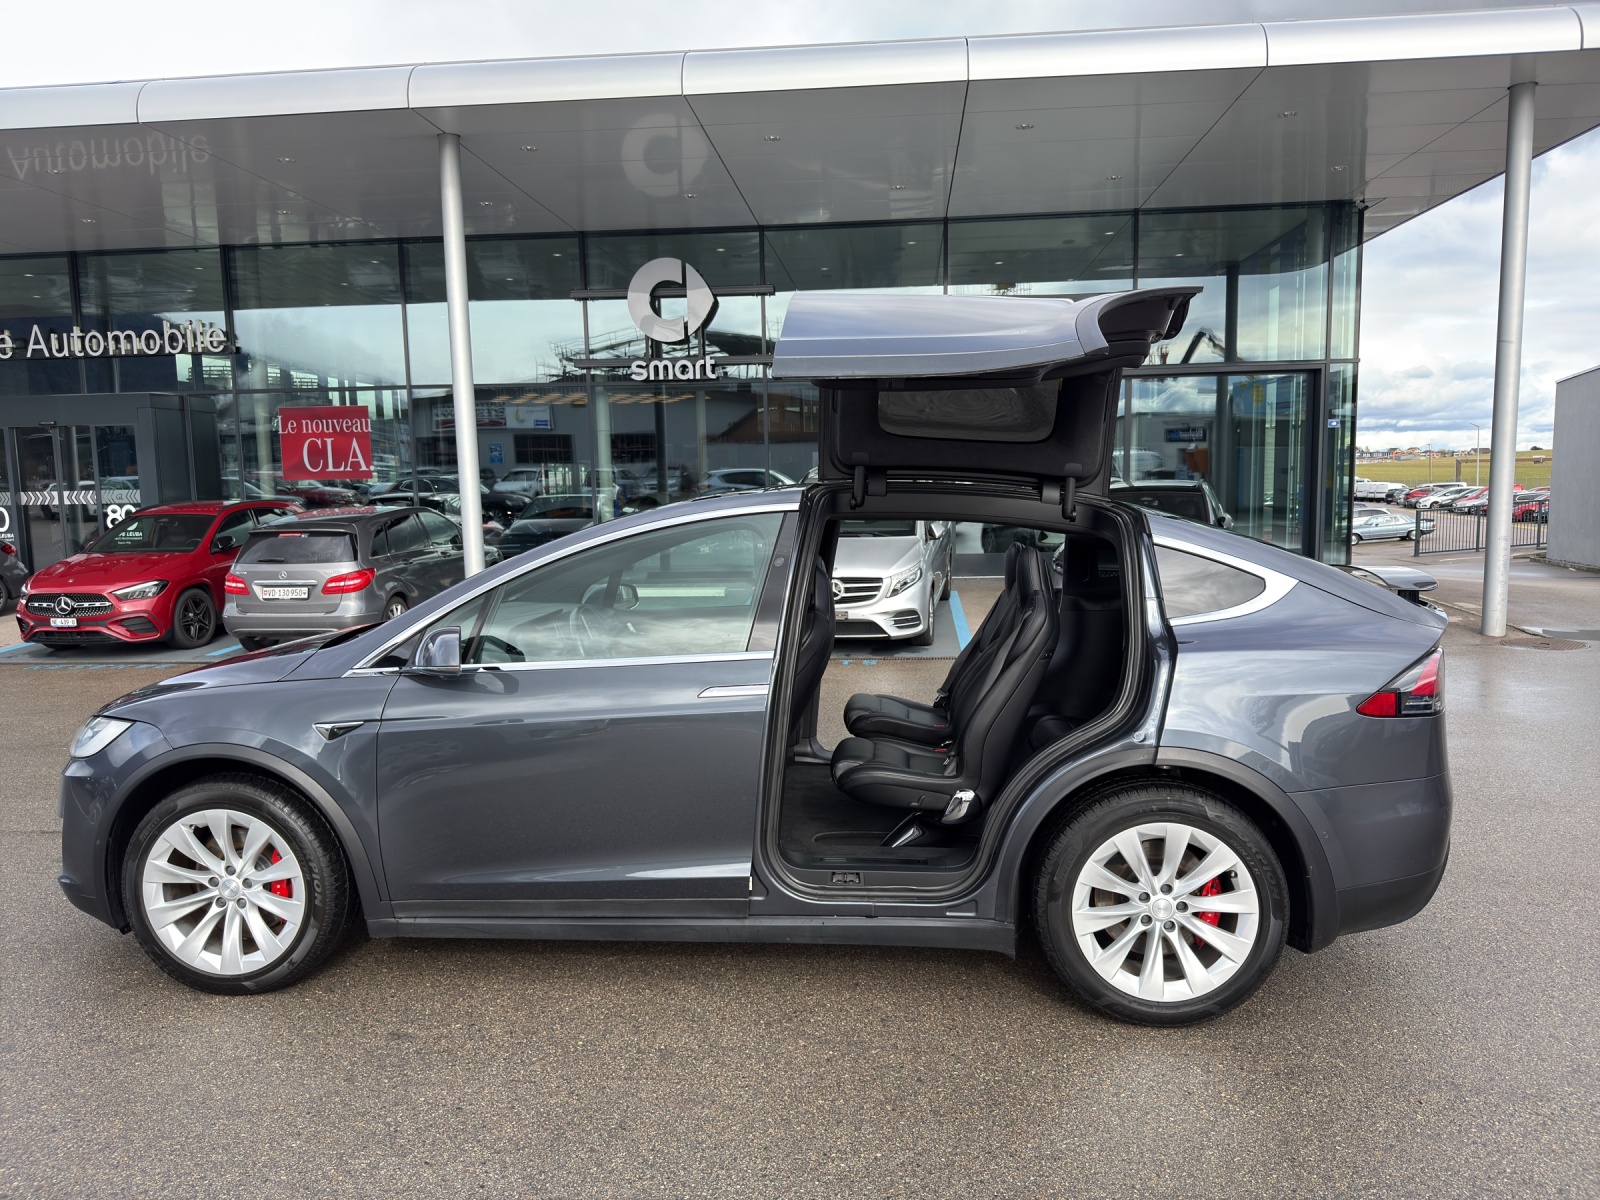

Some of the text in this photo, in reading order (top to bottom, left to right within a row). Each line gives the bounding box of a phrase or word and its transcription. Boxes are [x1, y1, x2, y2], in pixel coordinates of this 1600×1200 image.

[26, 320, 227, 358] Automobile
[630, 355, 717, 381] smart
[277, 415, 372, 434] Le nouveau
[303, 437, 375, 472] CLA.
